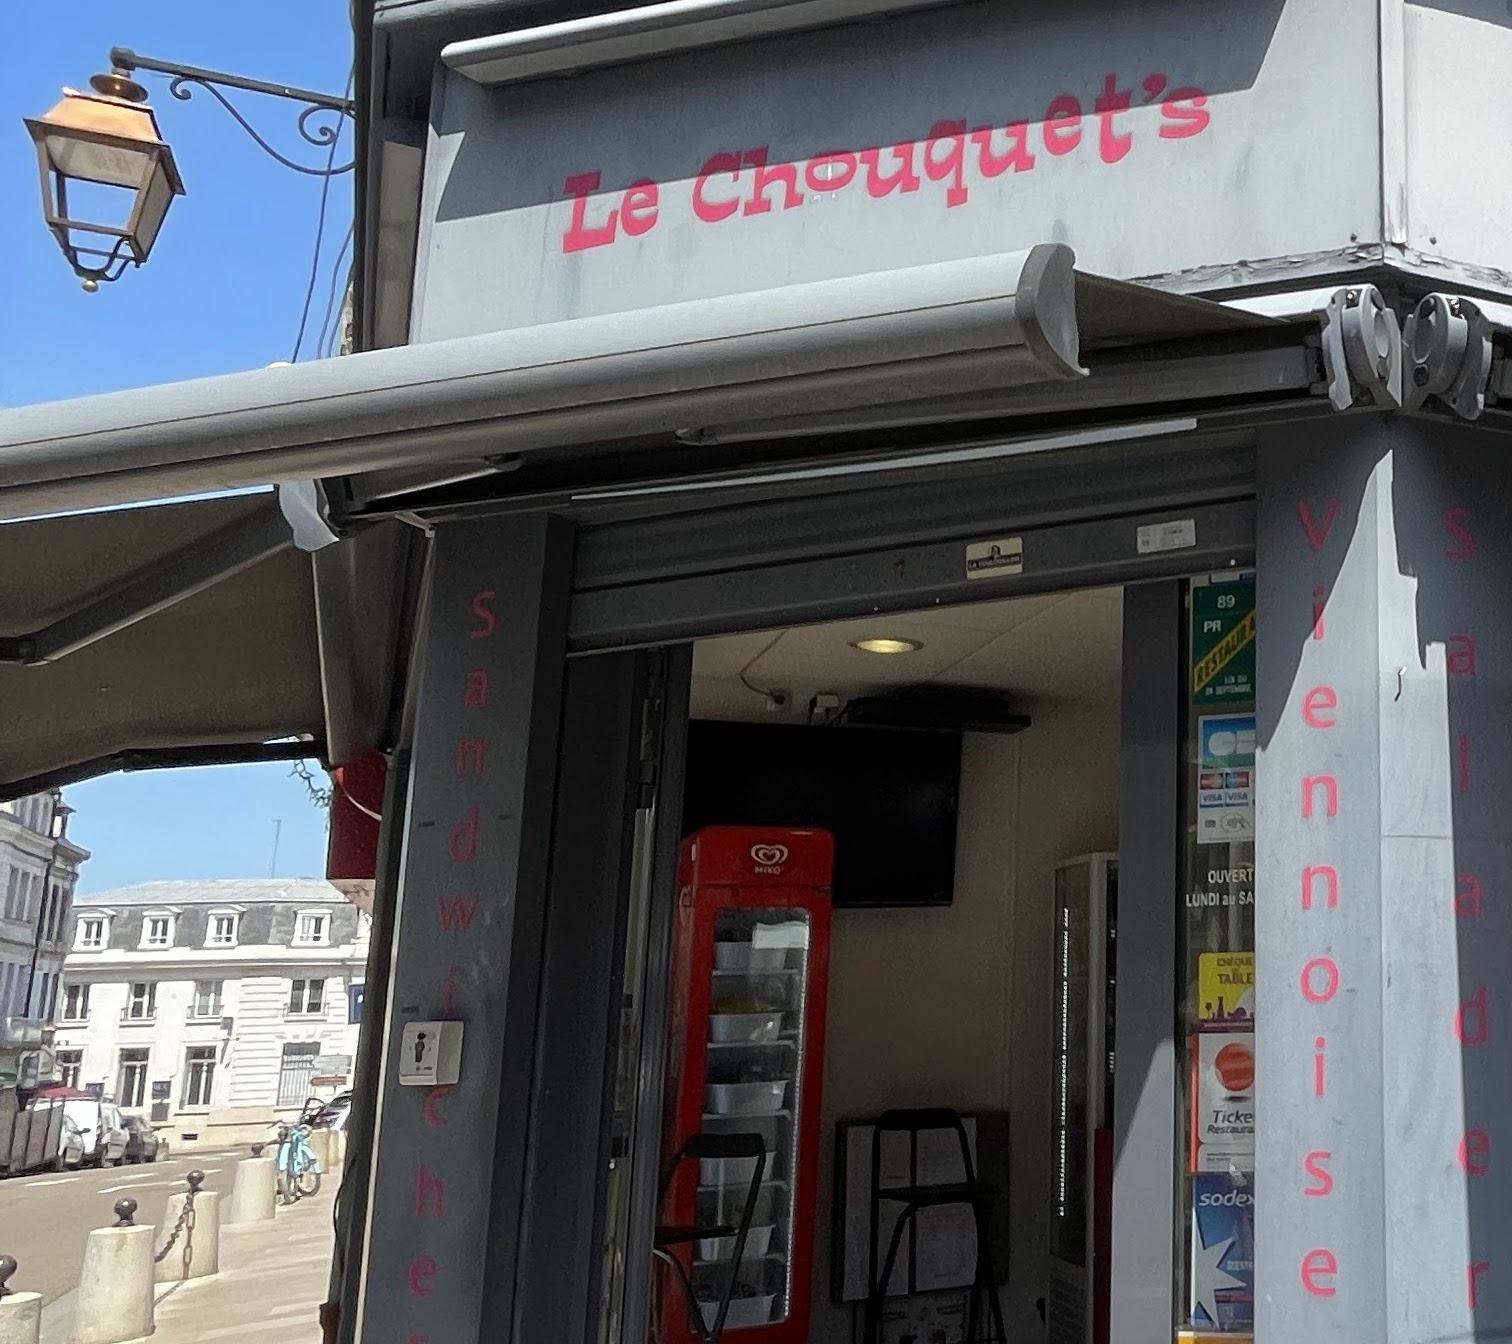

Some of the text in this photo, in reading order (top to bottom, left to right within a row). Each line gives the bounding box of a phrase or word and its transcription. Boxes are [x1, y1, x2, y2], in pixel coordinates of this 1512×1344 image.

[563, 73, 1210, 254] Le Chouquet's
[1216, 594, 1236, 609] 89
[1203, 619, 1222, 633] PR
[1227, 792, 1248, 801] VISA
[1207, 868, 1254, 884] OUVERT
[1185, 892, 1220, 907] LUNDI
[1222, 894, 1236, 906] au
